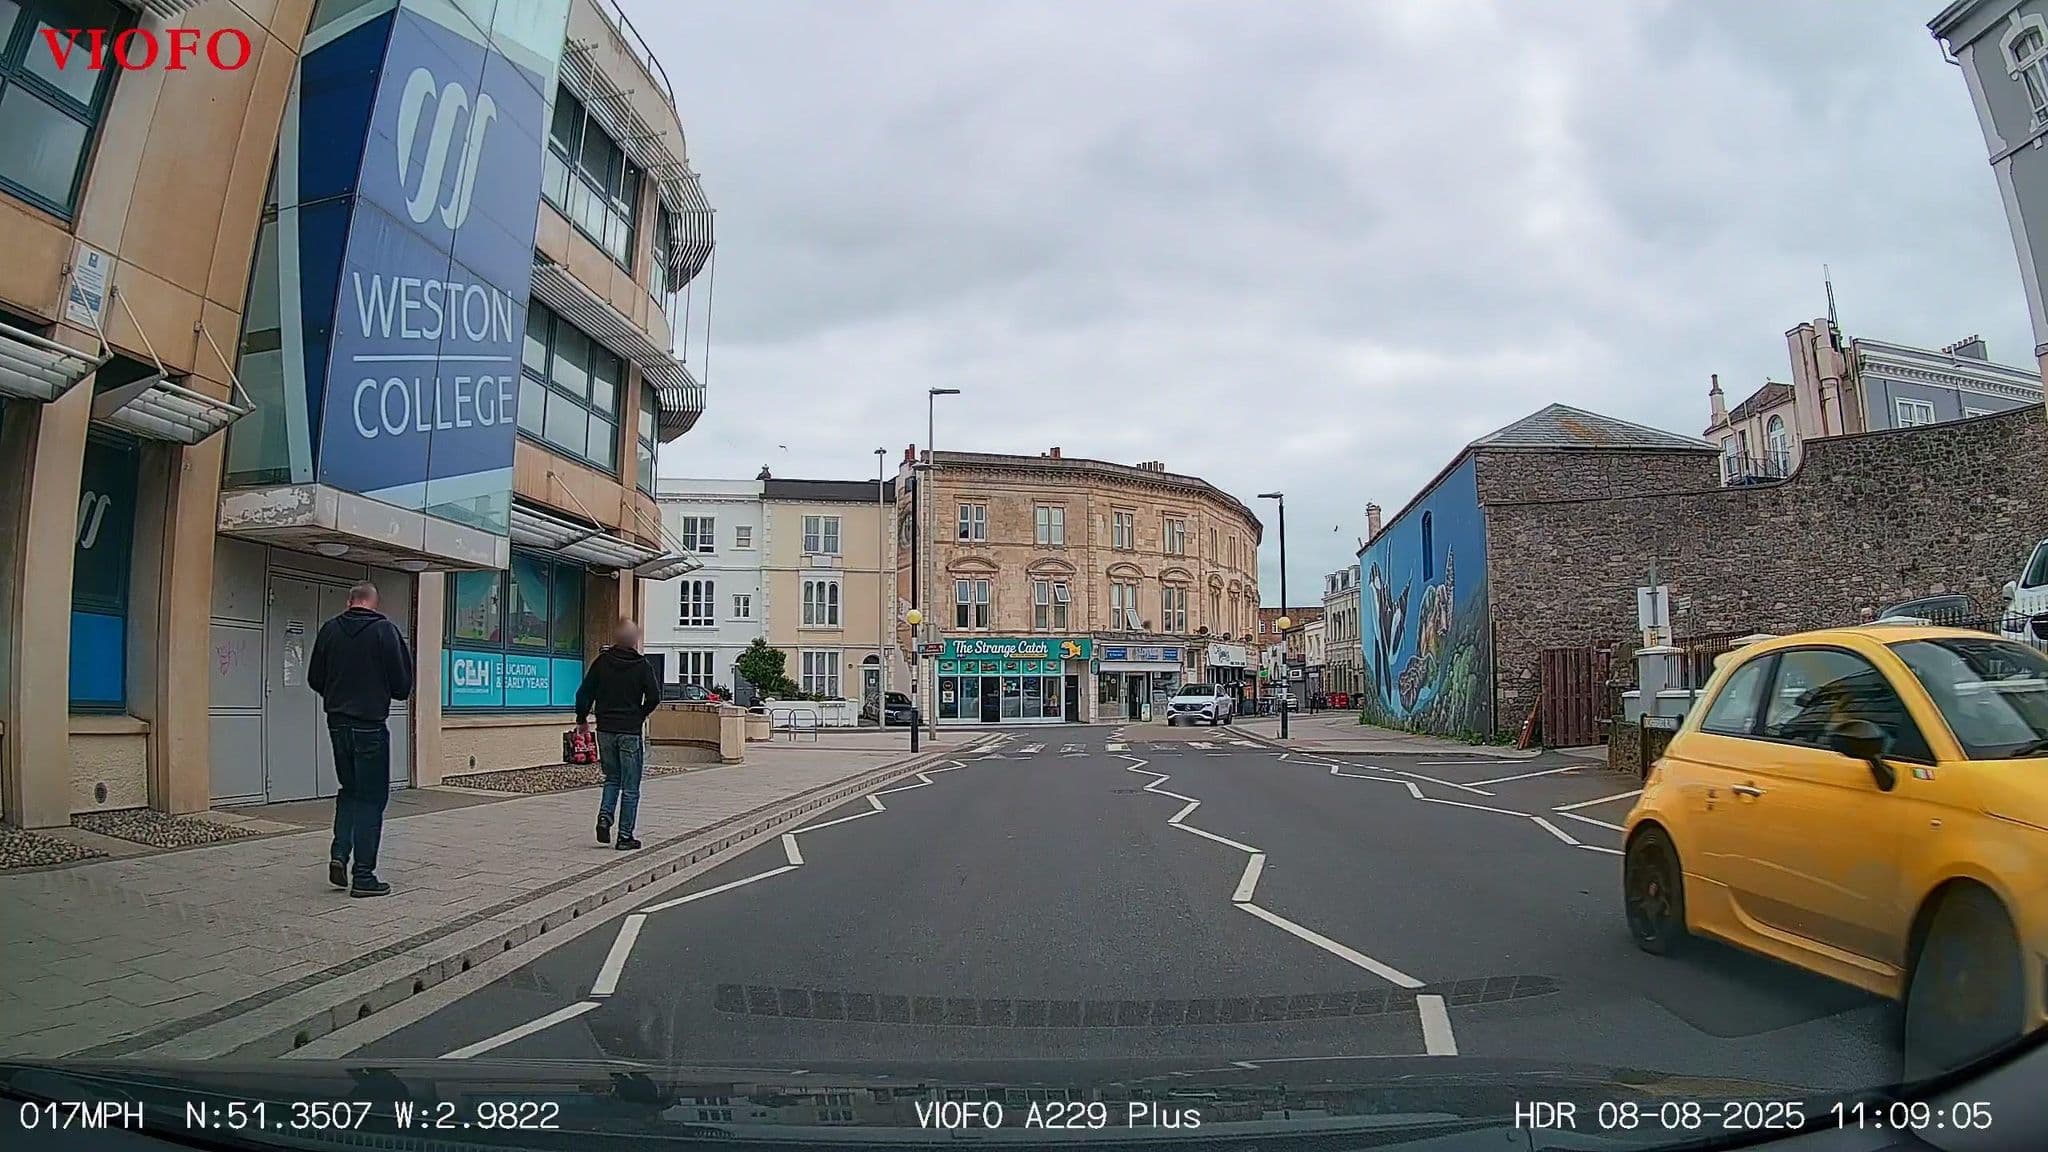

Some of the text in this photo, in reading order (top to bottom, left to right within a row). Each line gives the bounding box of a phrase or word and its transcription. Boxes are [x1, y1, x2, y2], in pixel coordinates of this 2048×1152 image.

[353, 272, 512, 342] WESTON
[353, 375, 513, 438] COLLEGE
[953, 640, 974, 654] The
[974, 640, 1017, 658] Strange
[1018, 640, 1048, 654] Catch
[526, 677, 549, 689] YEARS
